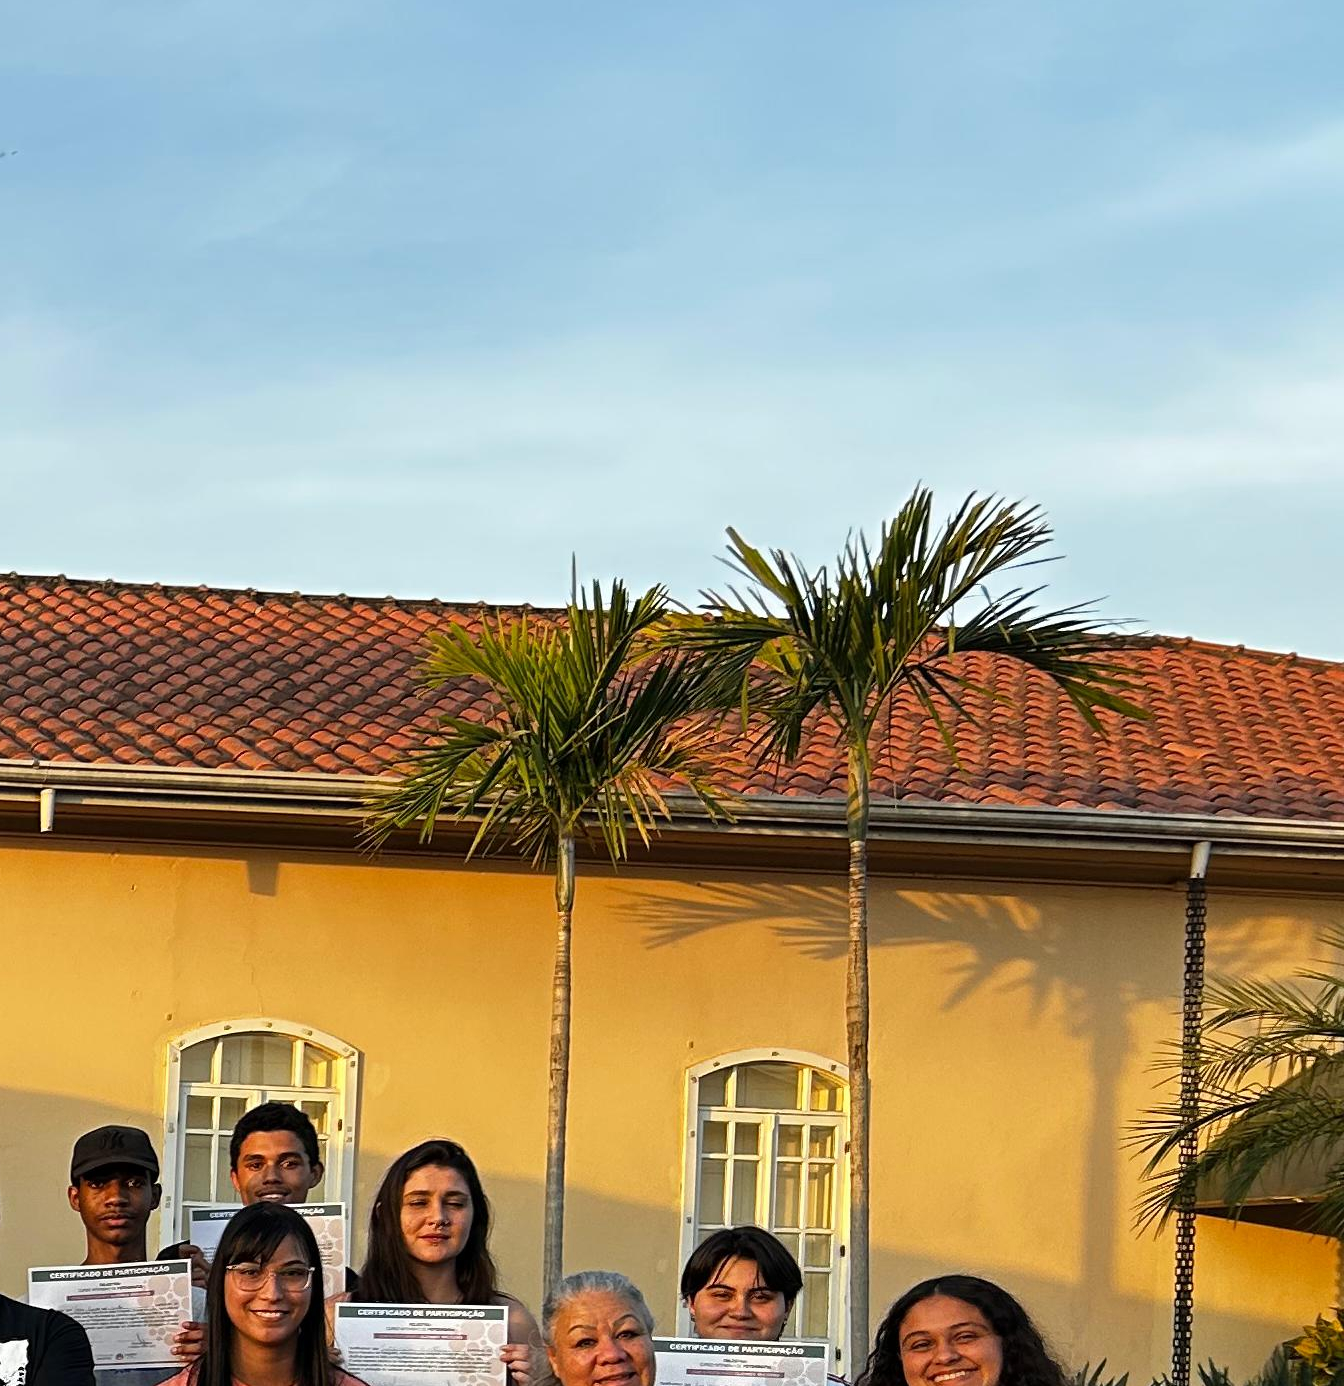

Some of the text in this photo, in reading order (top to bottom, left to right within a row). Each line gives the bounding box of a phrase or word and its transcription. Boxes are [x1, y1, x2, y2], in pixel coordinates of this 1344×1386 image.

[50, 1270, 100, 1279] CERTIFICADO
[115, 1265, 170, 1276] PARTICIPAÇÃO
[426, 1310, 485, 1318] PARTICIPAÇÃO
[670, 1343, 725, 1352] CERTIFICADO
[742, 1346, 804, 1355] PARTICIPAÇÃO
